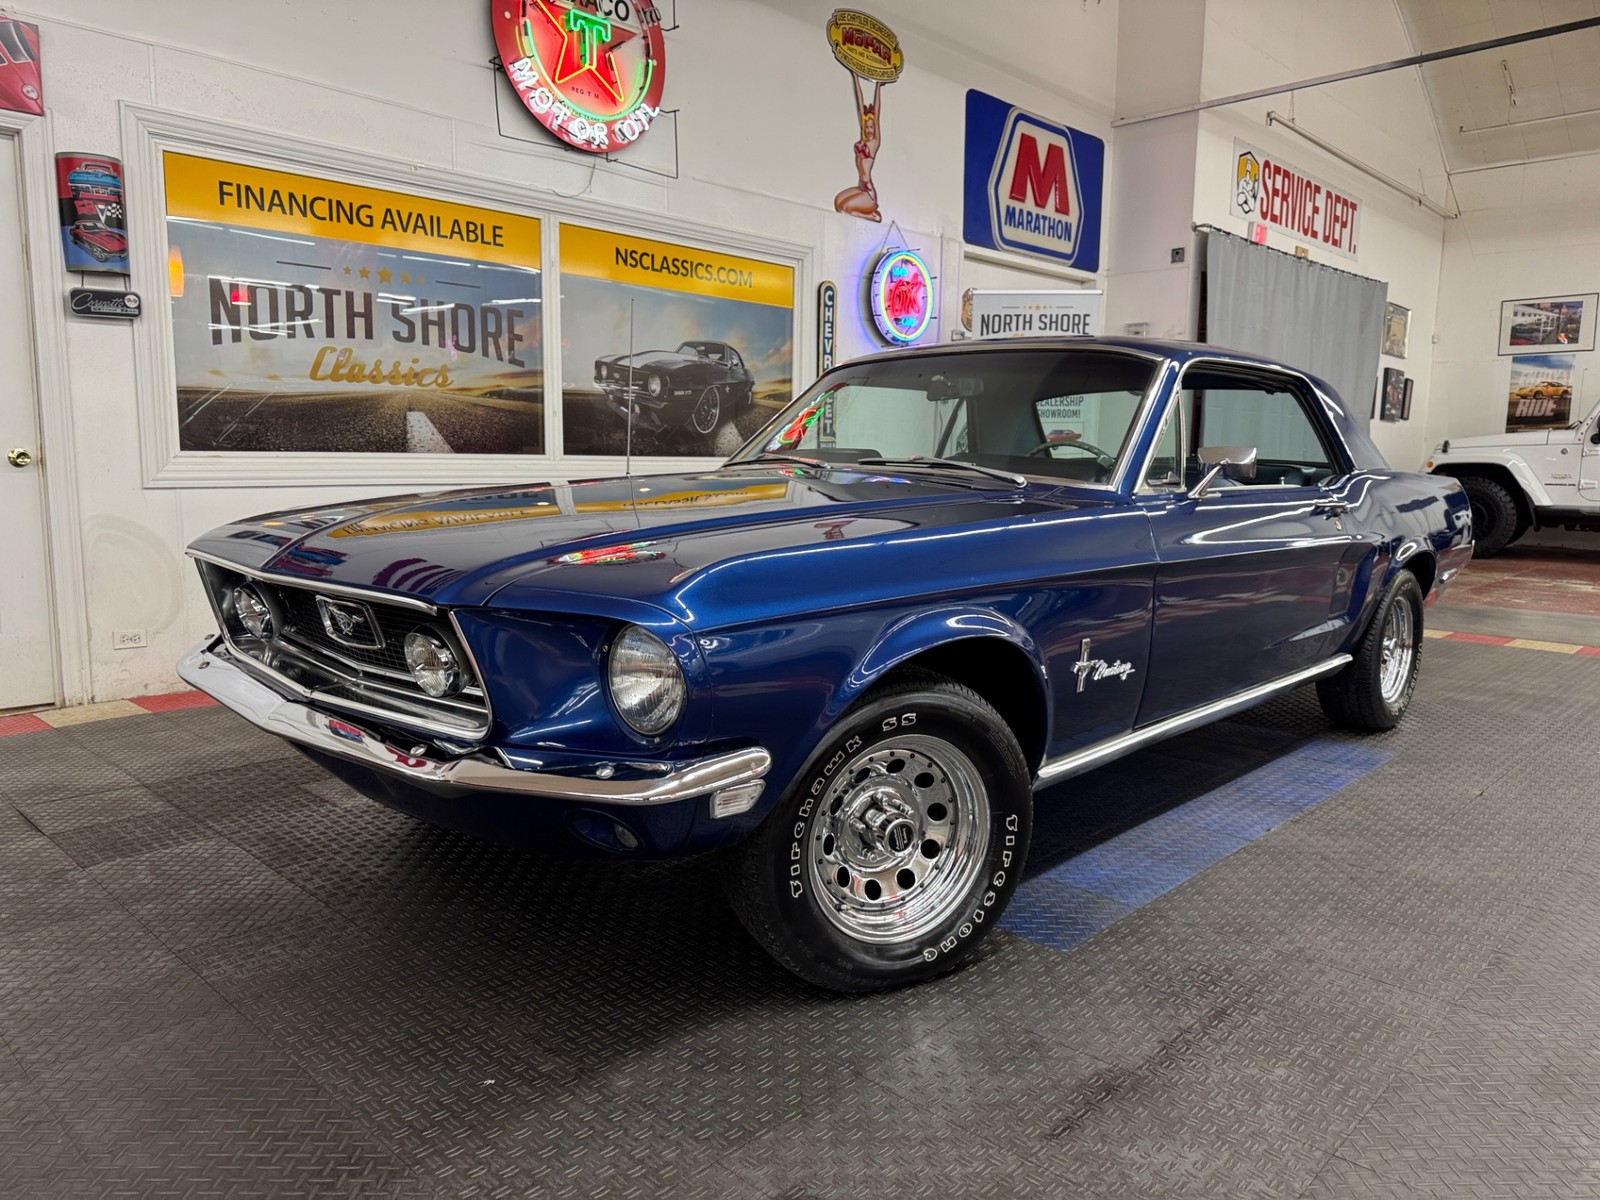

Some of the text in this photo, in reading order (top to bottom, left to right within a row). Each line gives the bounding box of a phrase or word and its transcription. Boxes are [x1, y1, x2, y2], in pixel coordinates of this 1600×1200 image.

[511, 57, 609, 148] MOTOR
[612, 103, 659, 143] OIL
[1009, 132, 1070, 216] M
[1260, 159, 1358, 255] SERVICE DEPT.
[218, 180, 505, 247] FINANCING AVAILABLE
[1004, 204, 1072, 242] MARATHON
[615, 246, 753, 289] NSCLASSICS.COM
[209, 277, 525, 368] NORTH SHORE
[980, 313, 1033, 337] NORTH
[1038, 313, 1091, 335] SHORE
[309, 345, 455, 388] Classics
[1515, 398, 1557, 417] RIDE
[790, 712, 917, 898] Firehawk SS
[923, 814, 1018, 962] Firestone
